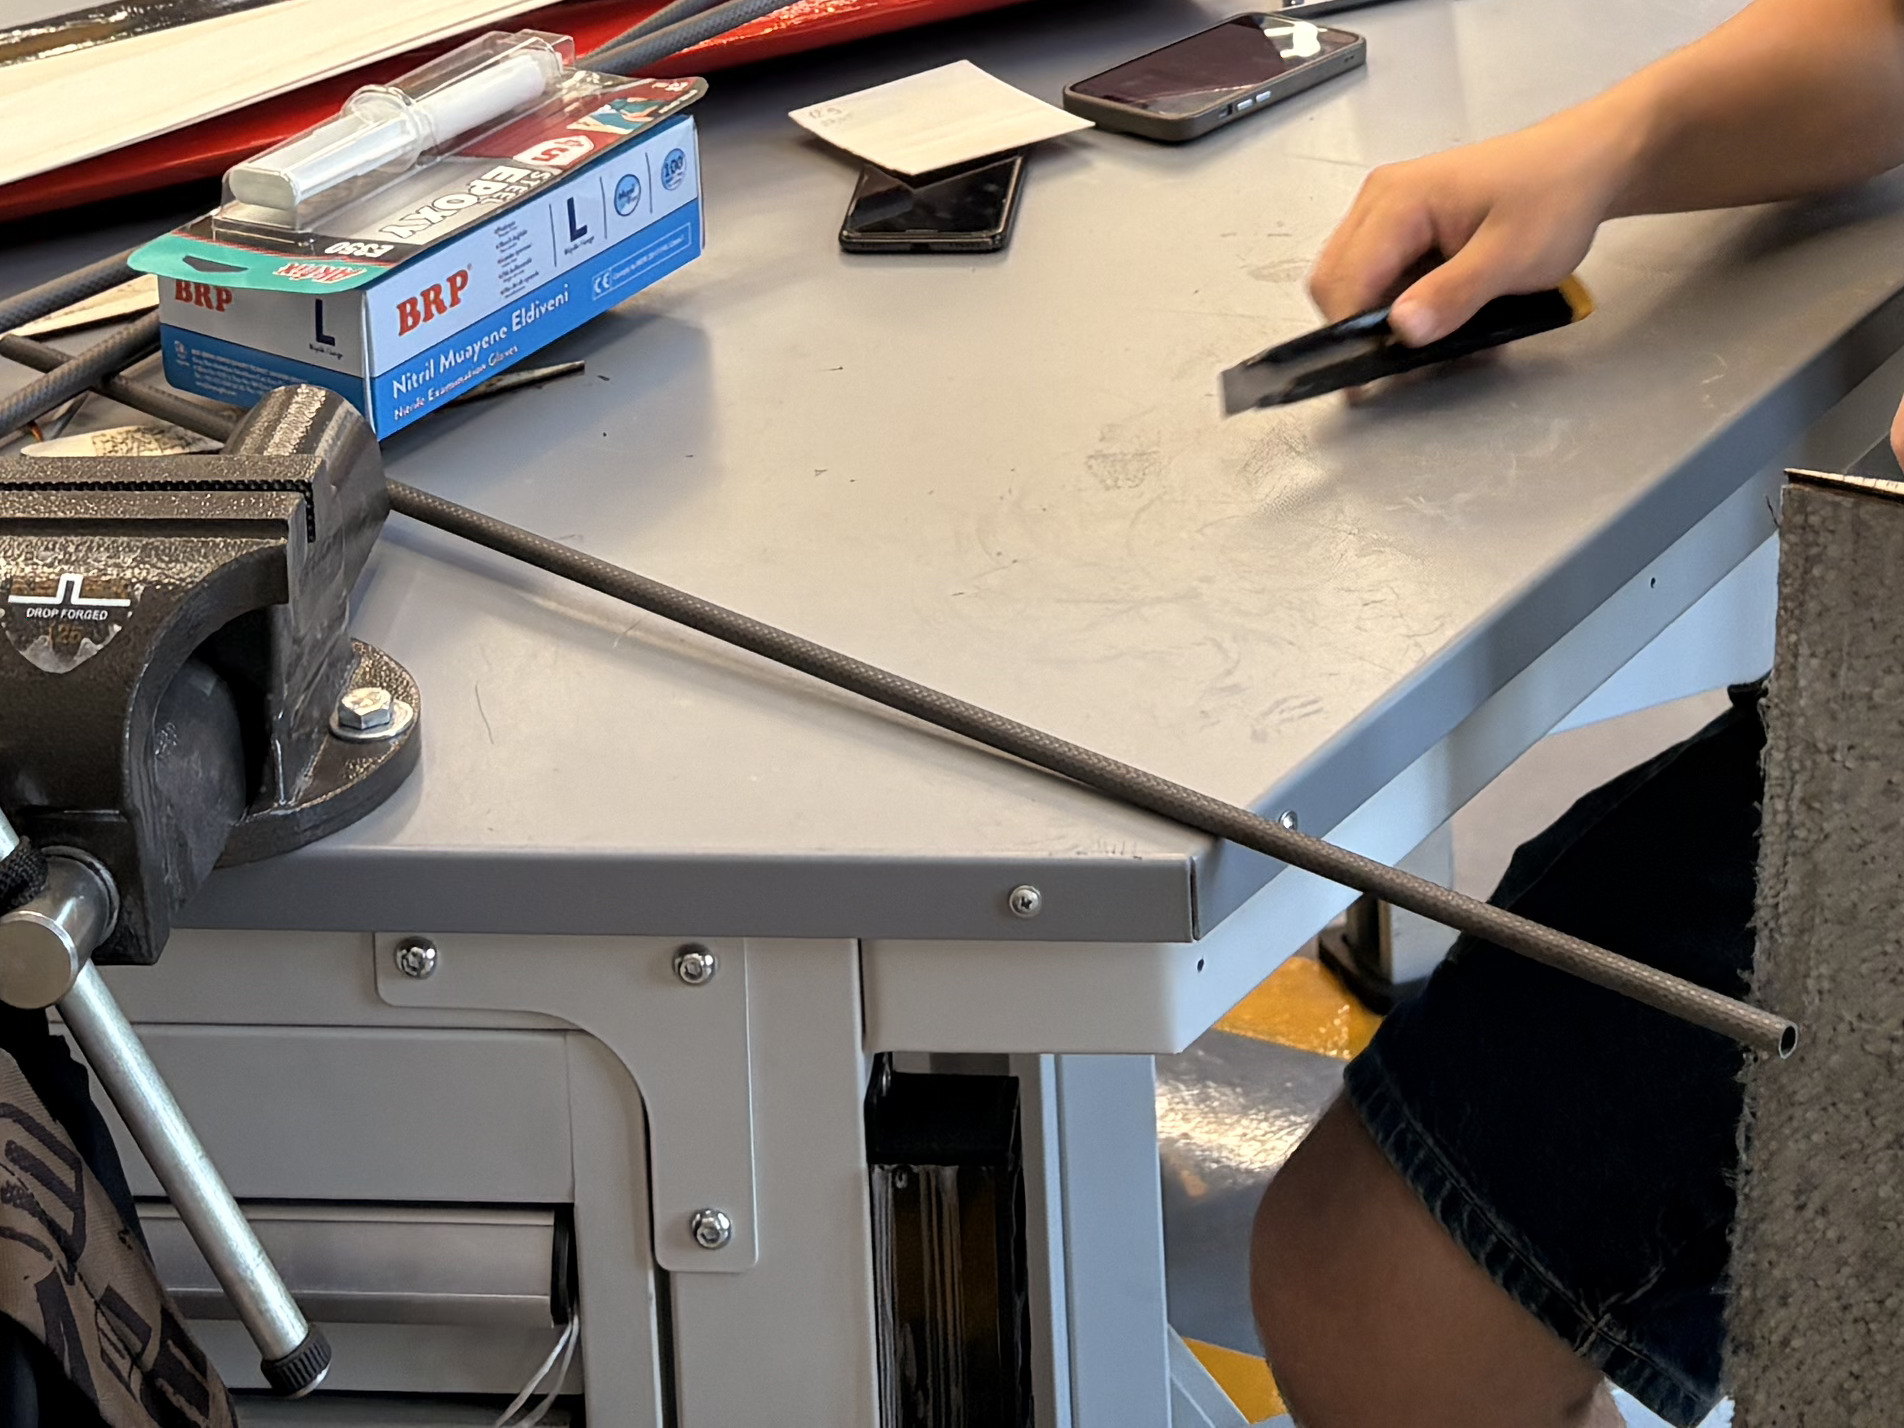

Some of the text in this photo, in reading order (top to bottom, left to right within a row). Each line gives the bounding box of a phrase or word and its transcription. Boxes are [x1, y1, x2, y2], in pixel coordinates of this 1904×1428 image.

[380, 165, 530, 239] EPOXY
[480, 170, 553, 204] STEEL
[566, 196, 588, 242] L
[175, 279, 233, 312] BRP
[396, 269, 469, 336] BRP
[315, 298, 335, 347] L
[392, 283, 569, 398] Nitril Muayene Eldiveni
[26, 606, 109, 621] DROP FORGED
